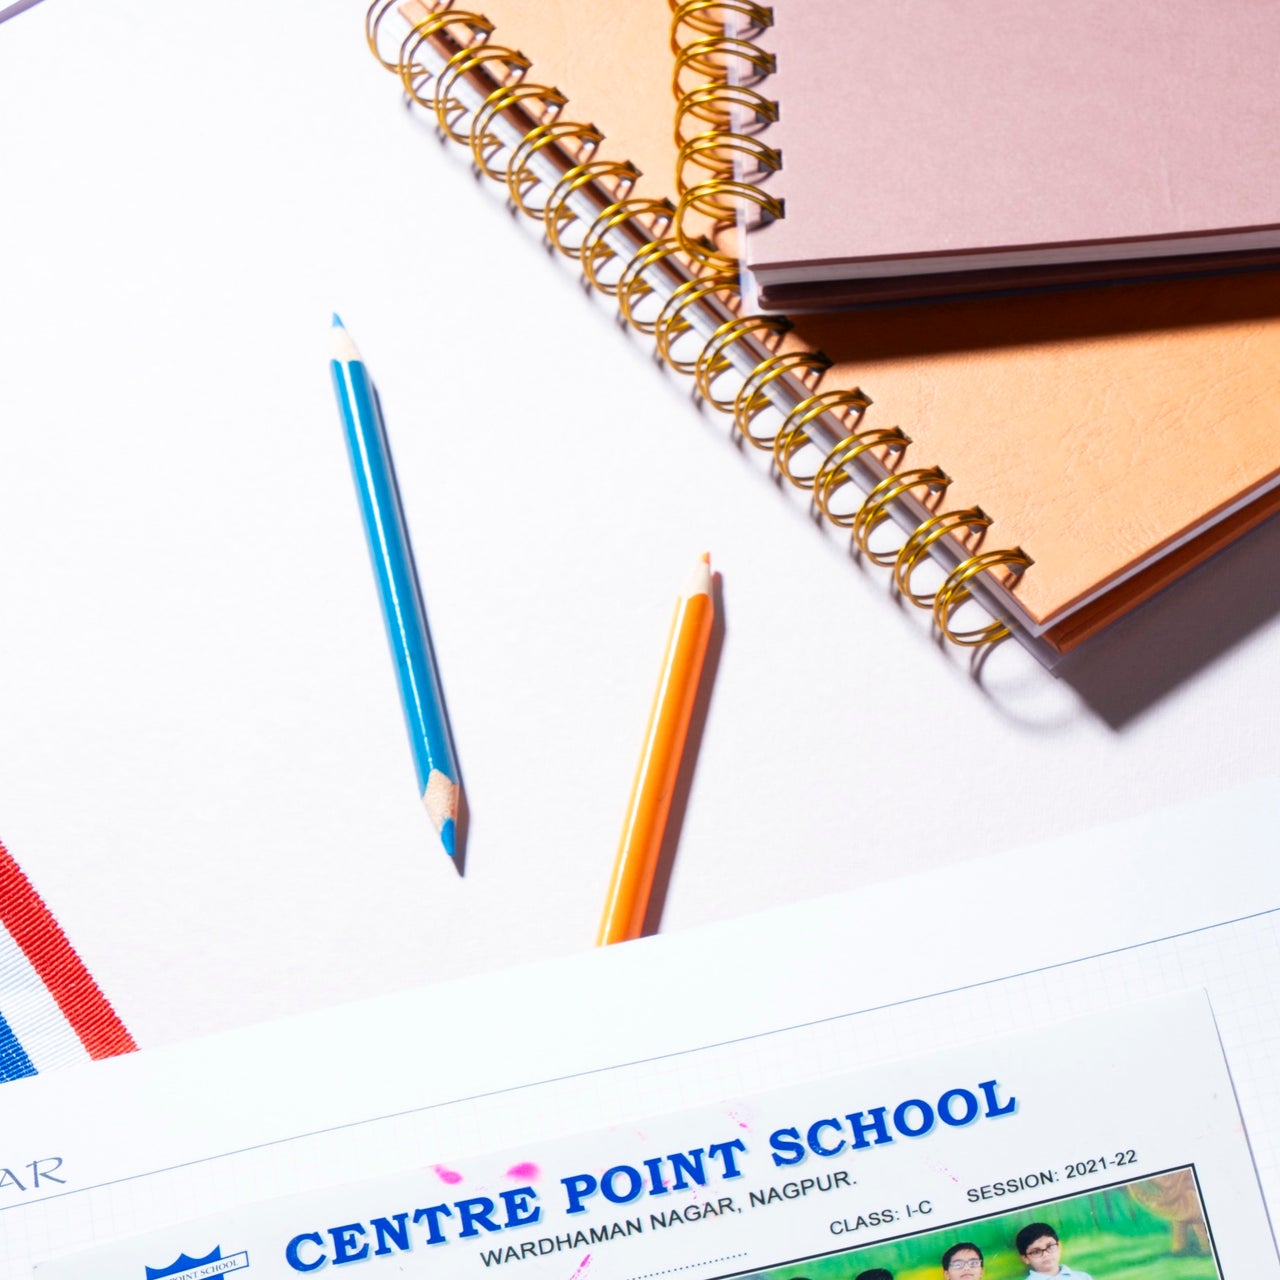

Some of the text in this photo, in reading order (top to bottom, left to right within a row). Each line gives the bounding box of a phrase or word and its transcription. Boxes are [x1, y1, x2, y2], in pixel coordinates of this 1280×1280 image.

[286, 1080, 1016, 1272] CENTRE POINT SCHOOL
[967, 1150, 1137, 1202] SESSION: 2021-22
[480, 1171, 856, 1267] WARDHAMAN NAGAR, NAGPUR.
[830, 1200, 932, 1235] CLASS: I-C
[200, 1259, 239, 1277] SCHOOL
